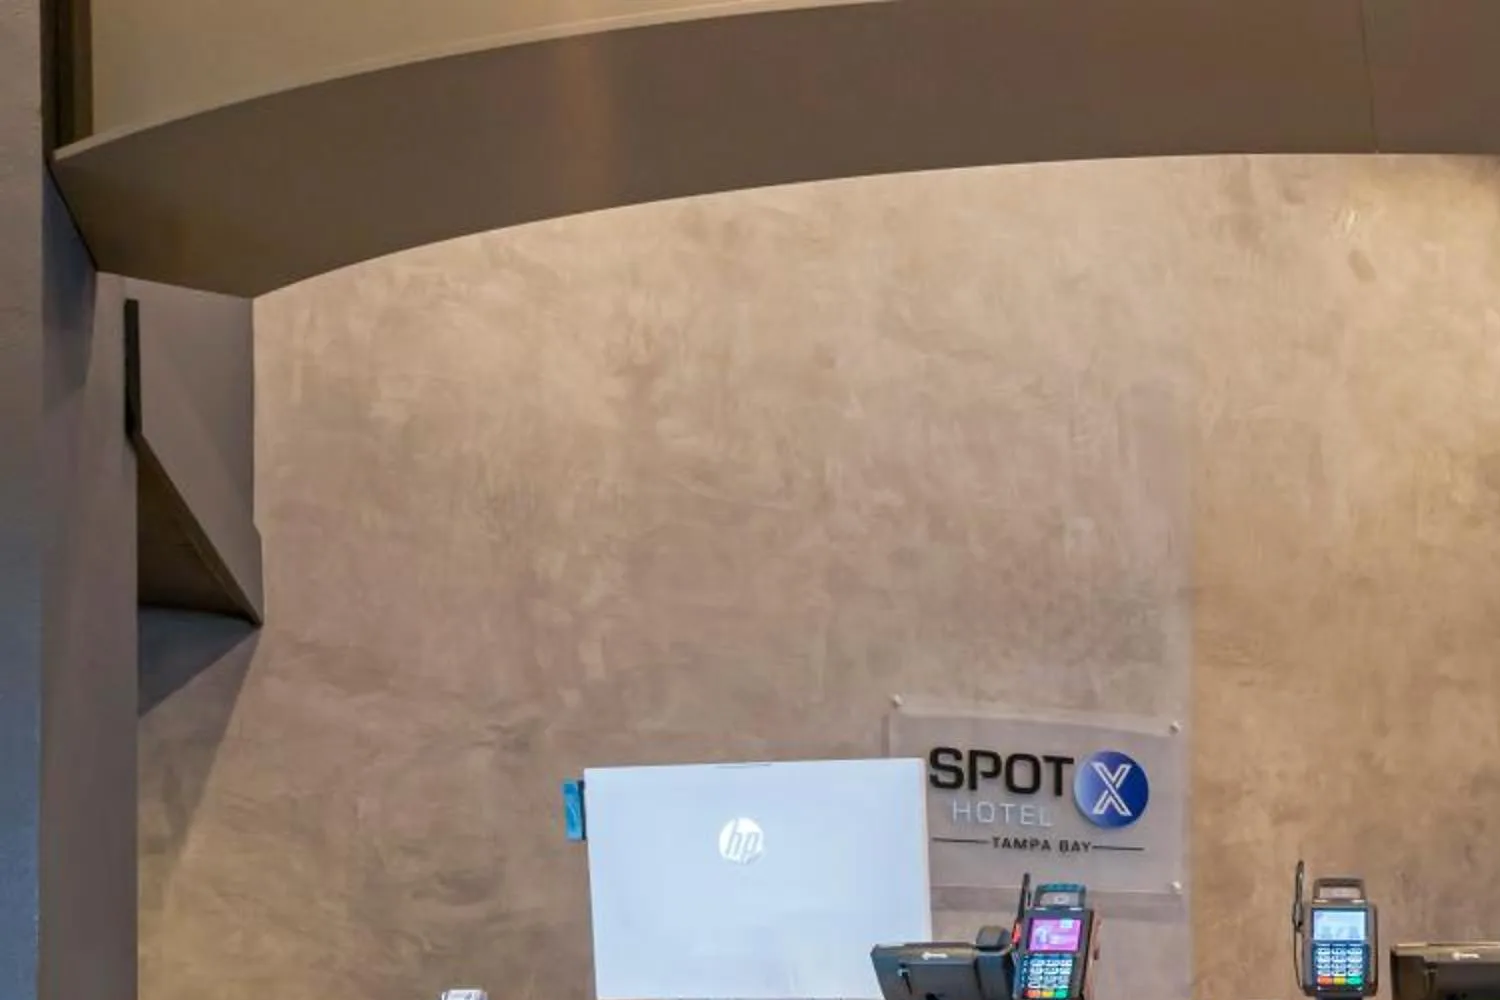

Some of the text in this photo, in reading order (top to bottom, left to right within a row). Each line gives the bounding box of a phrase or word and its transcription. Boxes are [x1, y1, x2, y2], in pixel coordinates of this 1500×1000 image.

[929, 747, 1133, 817] SPOT X
[952, 801, 1055, 827] HOTEL
[722, 817, 762, 865] hp
[992, 836, 1092, 854] TAMPA BAY
